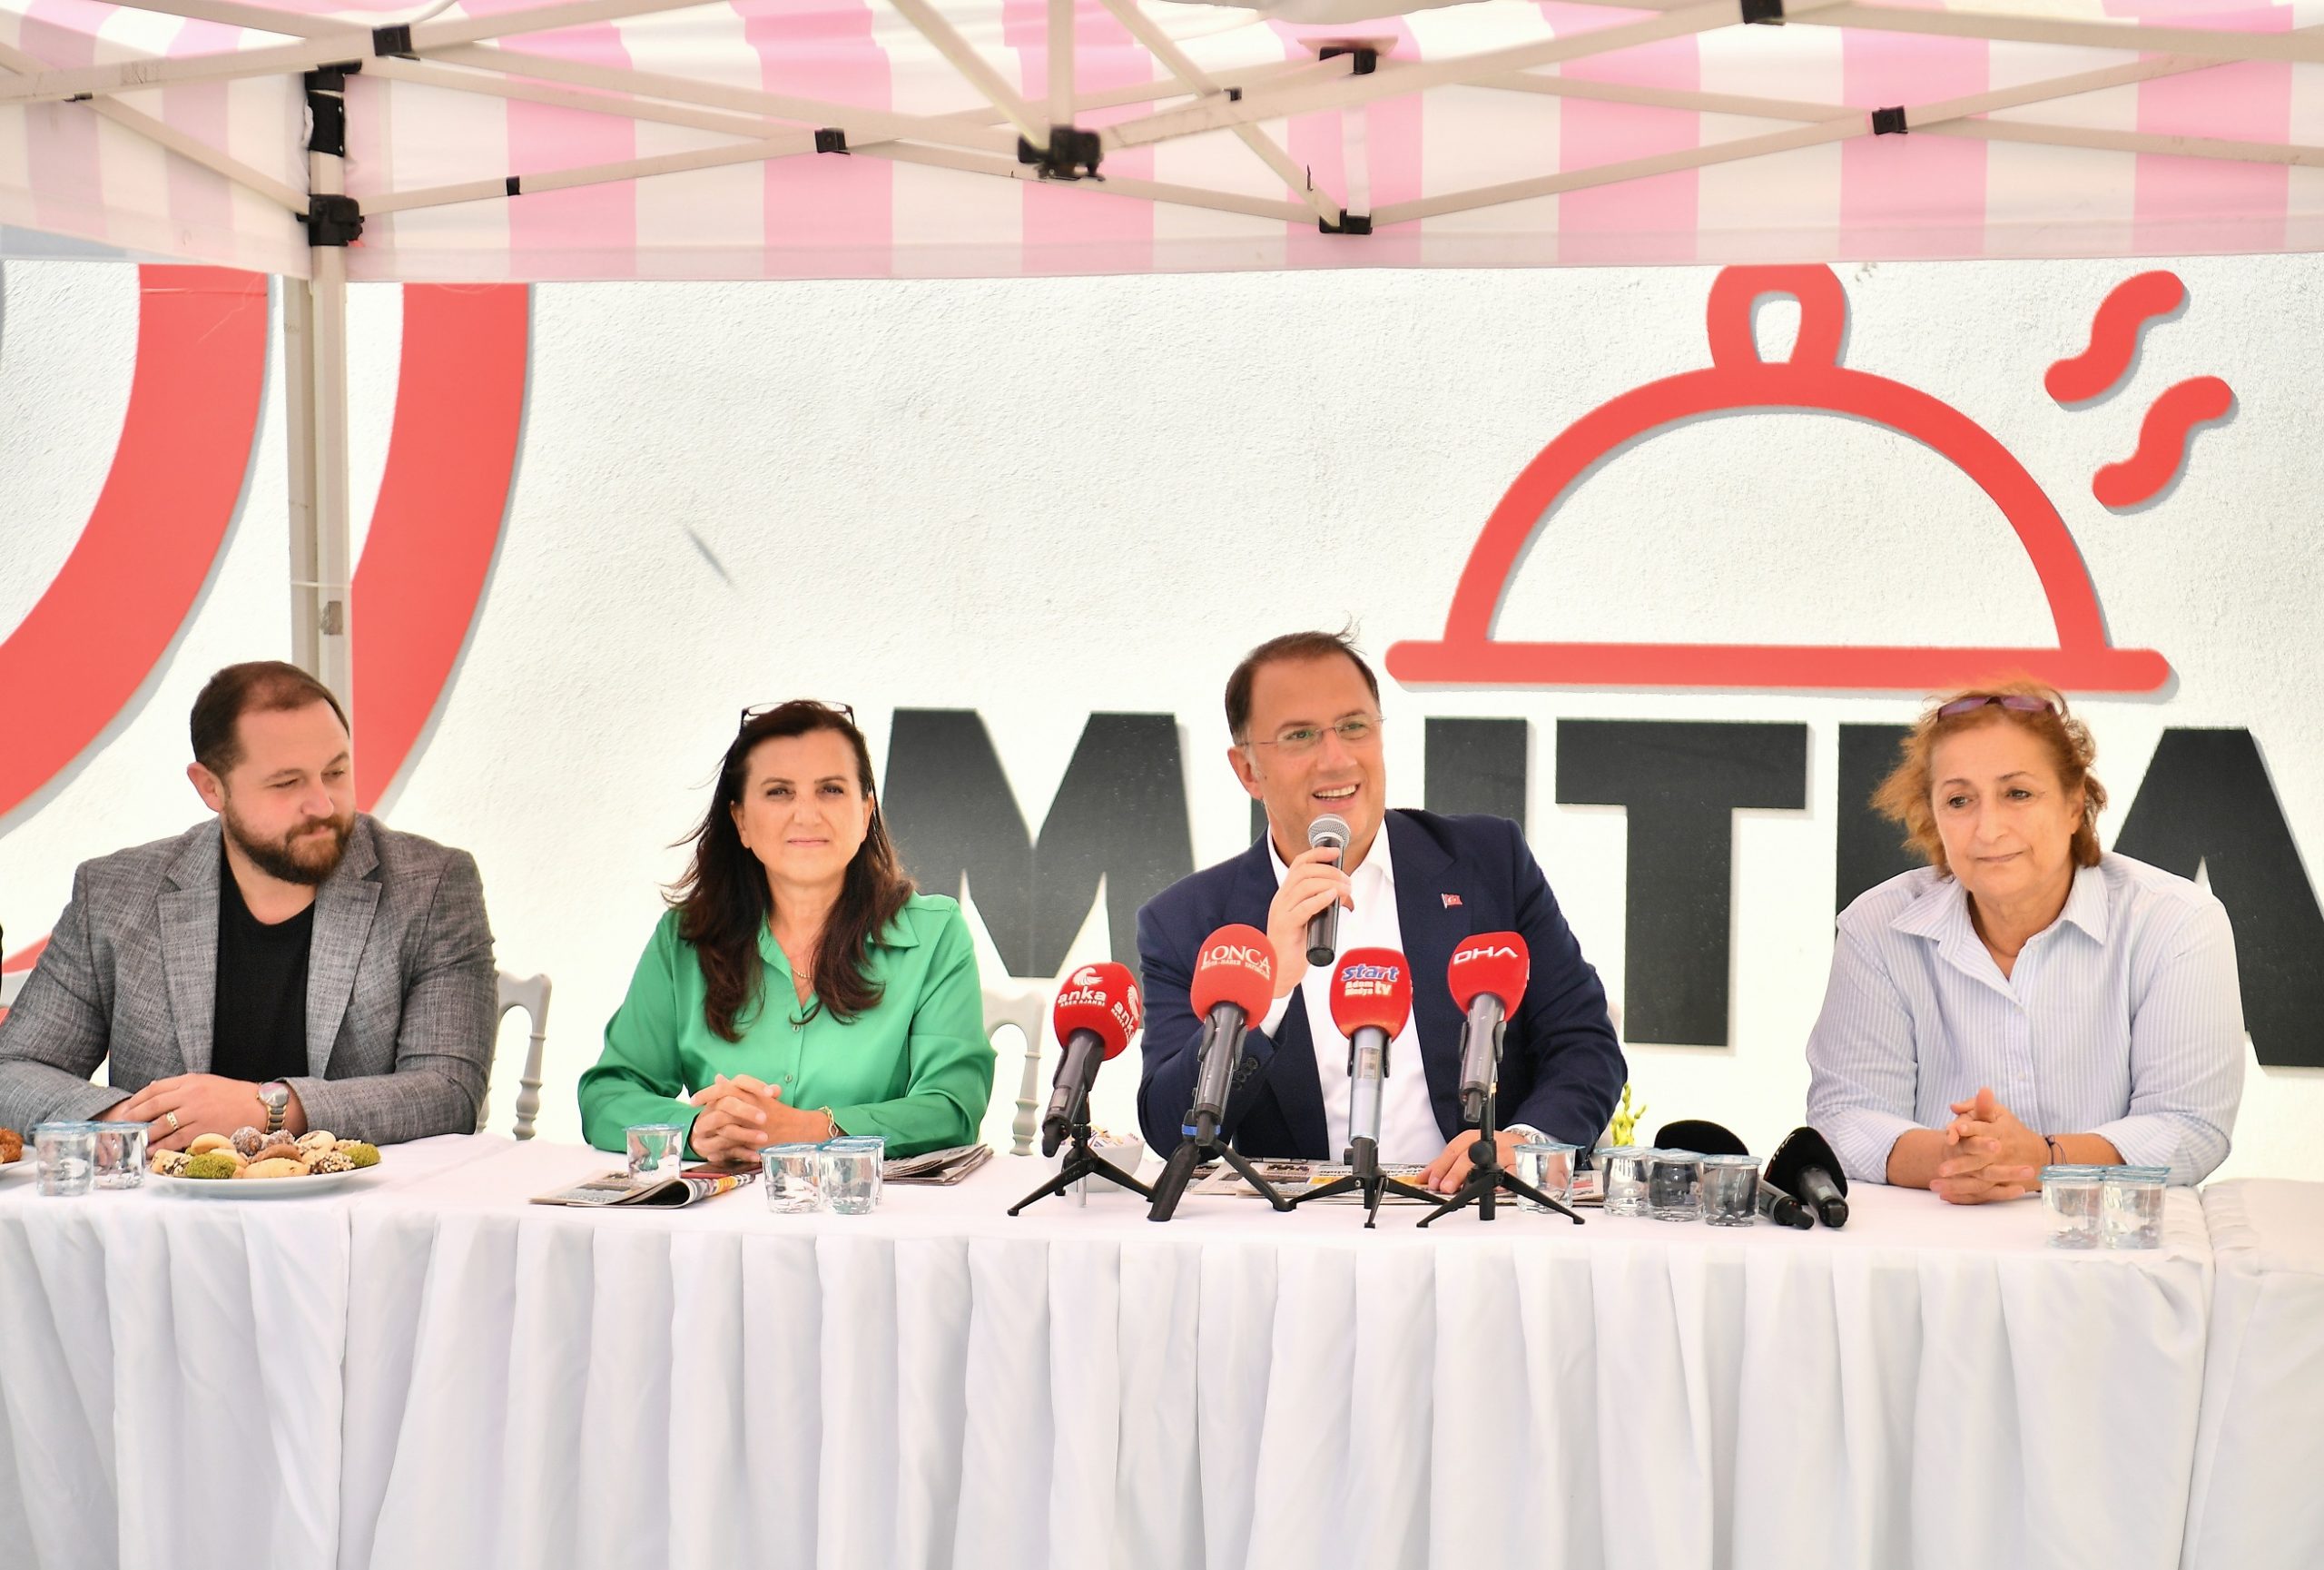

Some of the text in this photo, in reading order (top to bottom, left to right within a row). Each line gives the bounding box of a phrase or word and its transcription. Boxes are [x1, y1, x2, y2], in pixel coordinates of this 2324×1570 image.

[1453, 945, 1519, 965] DHA
[1341, 963, 1400, 982] start
[1057, 985, 1107, 1004] anka
